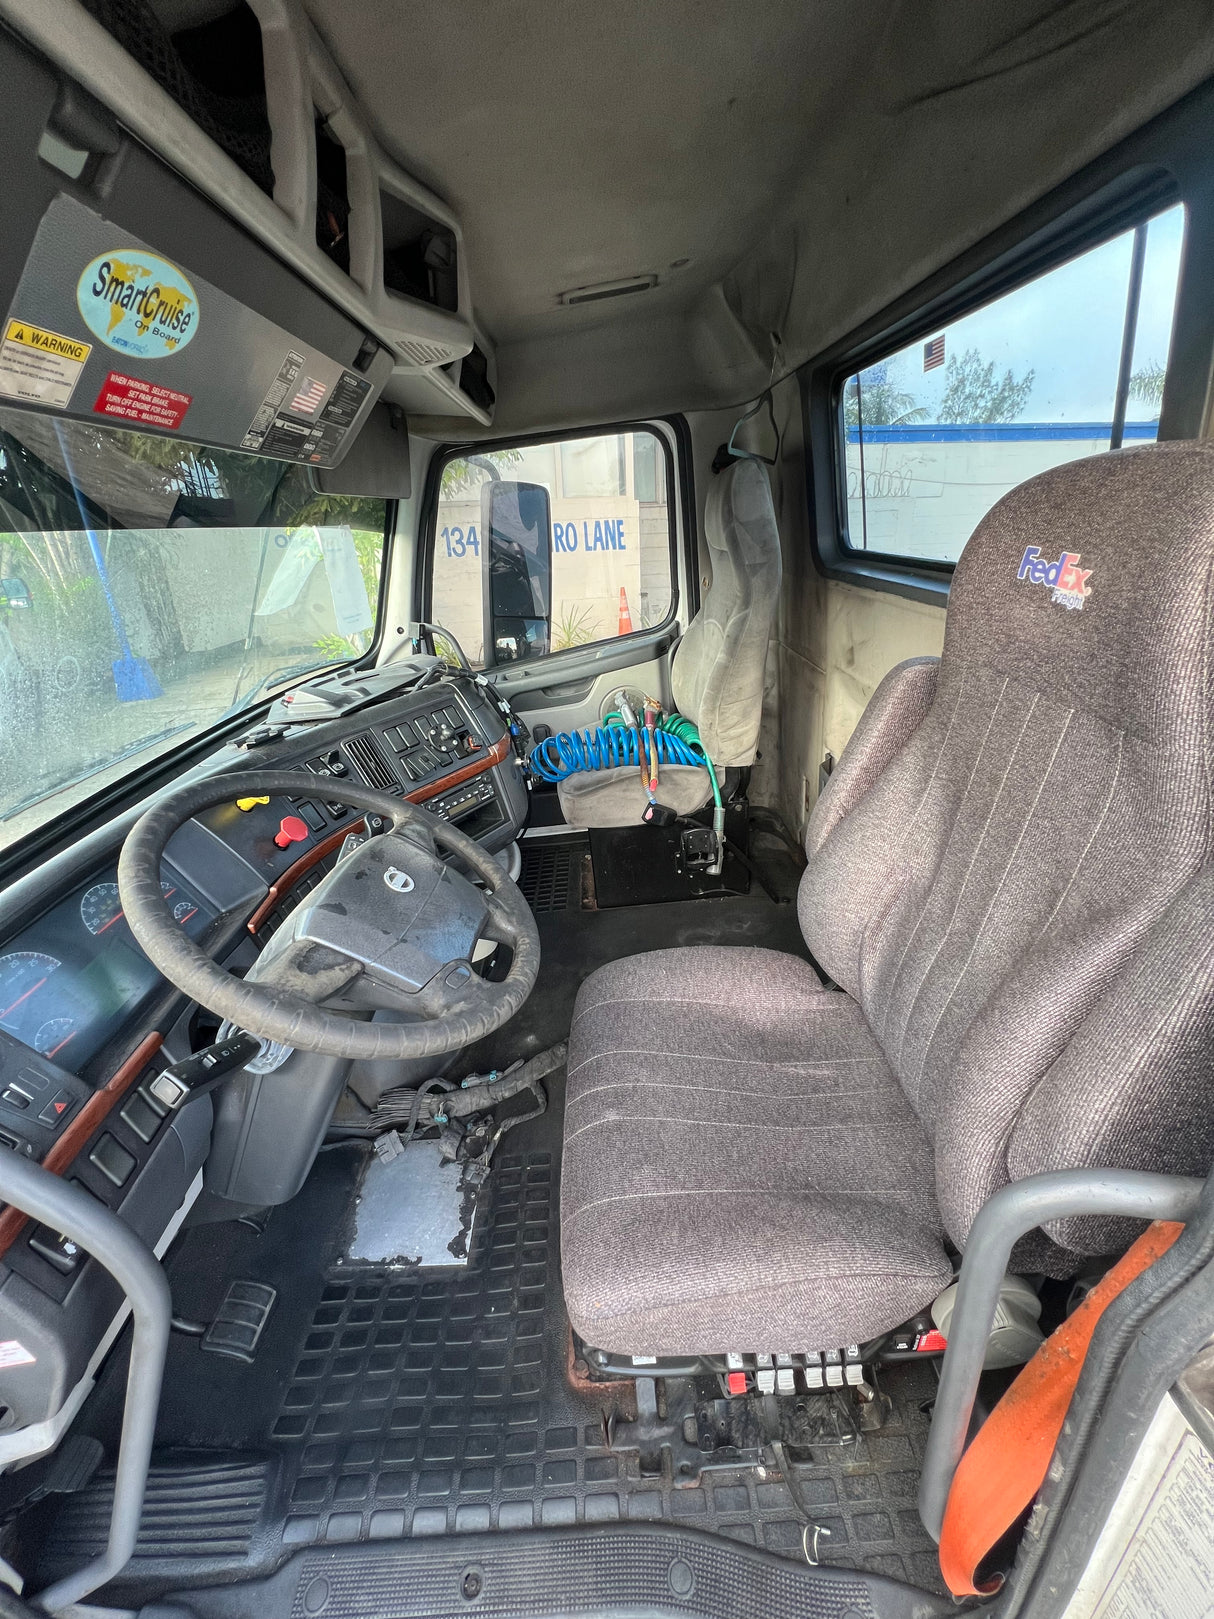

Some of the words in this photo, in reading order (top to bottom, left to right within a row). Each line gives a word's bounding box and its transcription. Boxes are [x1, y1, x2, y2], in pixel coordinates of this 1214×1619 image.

[92, 261, 192, 334] SmartCruise
[134, 320, 149, 332] On
[152, 327, 181, 344] Board
[32, 332, 83, 358] WARNING
[111, 374, 127, 386] WHEN
[152, 387, 170, 398] SELECT
[170, 392, 189, 405] NEUTRAL
[128, 390, 139, 398] SET
[139, 392, 151, 402] PARK
[106, 393, 122, 404] TURN
[122, 399, 132, 407] OFF
[132, 401, 151, 411] ENGINE
[105, 403, 126, 415] SAVING
[125, 409, 138, 418] FUEL
[141, 412, 174, 426] MAINTENANCE
[552, 521, 579, 553] RO
[583, 519, 627, 552] LANE
[1017, 545, 1093, 595] FedEx
[1051, 591, 1084, 609] Freight
[9, 960, 20, 969] 20
